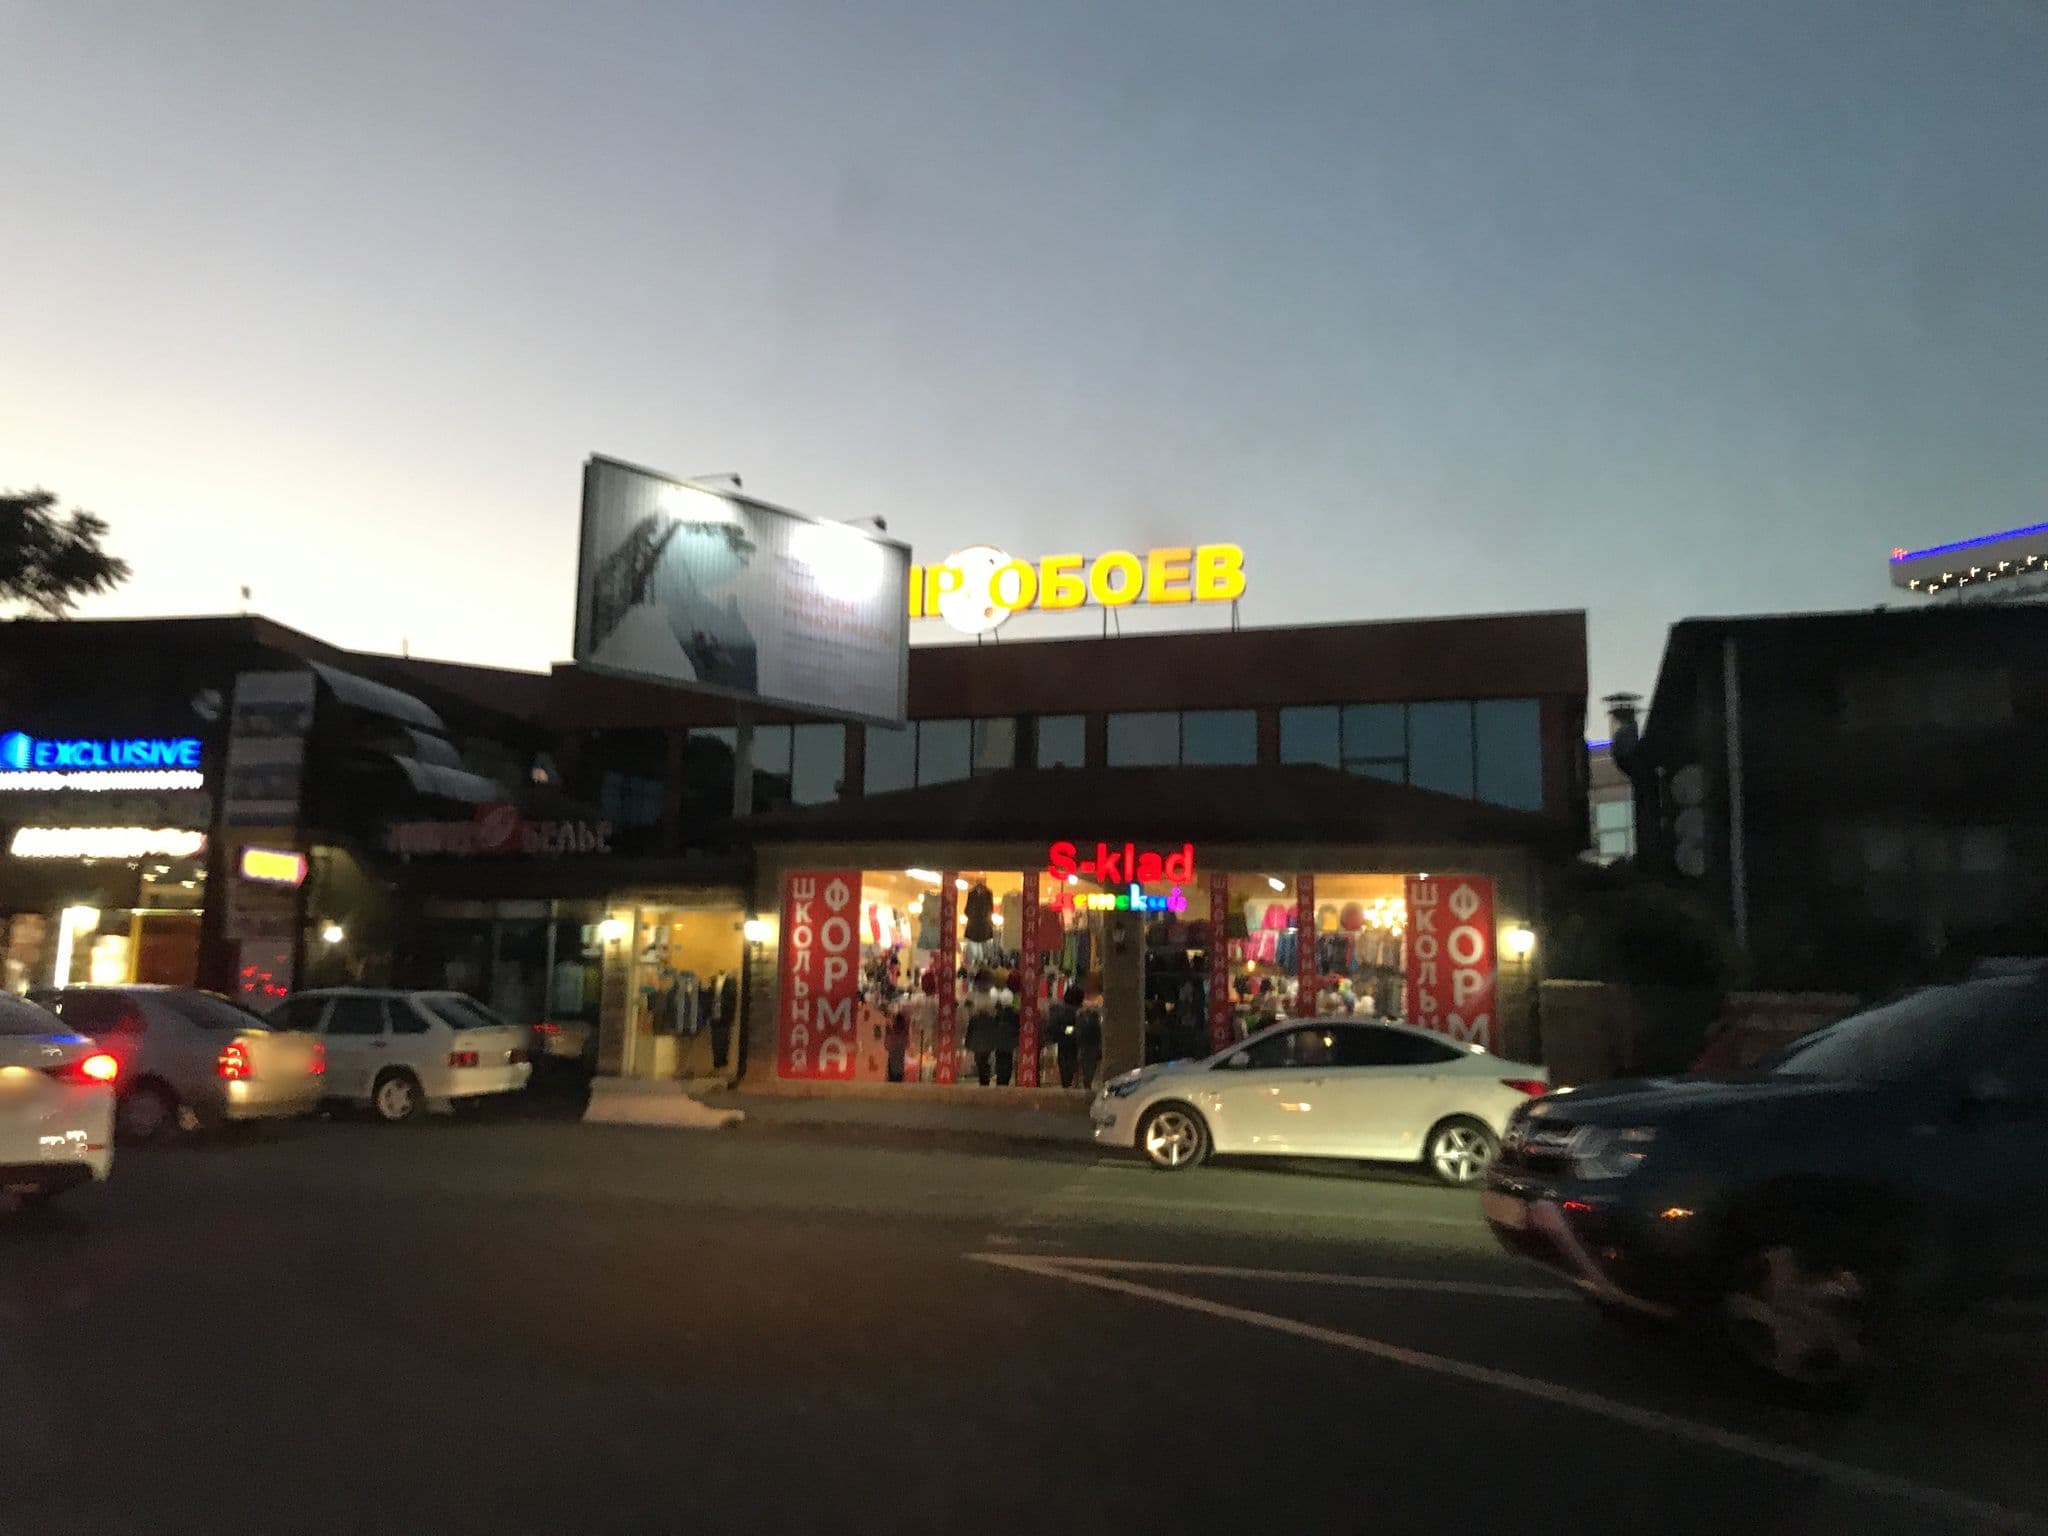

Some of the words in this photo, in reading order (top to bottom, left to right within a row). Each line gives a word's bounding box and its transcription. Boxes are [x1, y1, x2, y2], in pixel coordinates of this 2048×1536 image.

[988, 543, 1247, 613] ОБОЕВ
[34, 738, 203, 767] EXCLUSIVE
[1048, 840, 1195, 884] S-klad
[789, 877, 816, 1074] ШКОЛЬНАЯ
[815, 877, 853, 1074] ФОРМА
